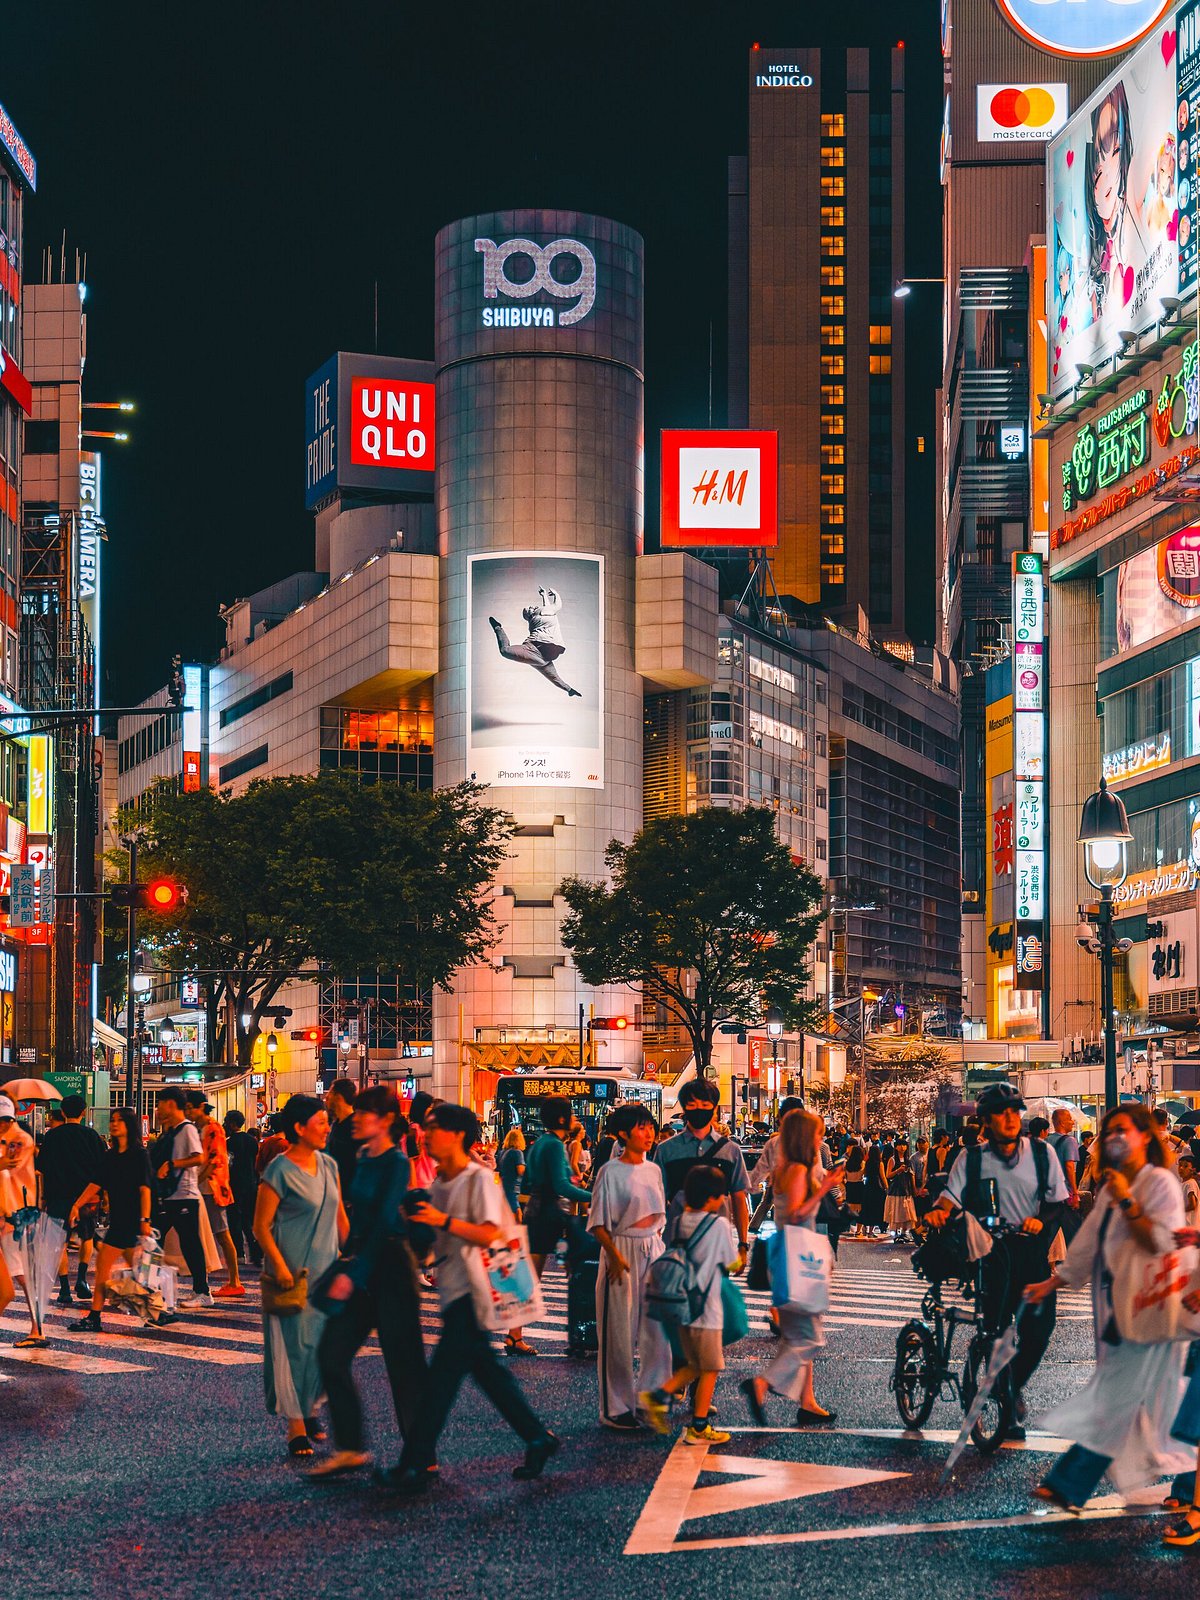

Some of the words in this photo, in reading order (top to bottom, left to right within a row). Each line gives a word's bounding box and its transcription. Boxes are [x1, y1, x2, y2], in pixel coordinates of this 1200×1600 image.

[756, 75, 813, 87] INDIGO
[768, 65, 800, 73] HOTEL
[993, 129, 1053, 139] mastercard
[474, 238, 596, 326] 109
[482, 307, 554, 327] SHIBUYA
[313, 379, 330, 434] THE
[361, 389, 420, 423] UNI
[307, 425, 335, 490] PRIME
[361, 424, 426, 460] QLO
[1006, 452, 1019, 460] 7F
[1098, 411, 1147, 489] 西村
[80, 462, 96, 499] BIC
[692, 469, 749, 506] H&M
[1062, 462, 1072, 512] 渋谷
[80, 504, 96, 597] CAMERA
[1020, 577, 1038, 628] 渋谷西村
[1022, 644, 1036, 655] 4F
[497, 770, 525, 779] iPhone
[525, 770, 535, 778] 14
[523, 759, 546, 767] ダンス!
[32, 768, 43, 799] レイク
[1019, 800, 1029, 835] パーラー
[1030, 795, 1039, 830] フルーツ
[21, 869, 32, 923] 渋谷駅前
[42, 872, 51, 922] スクランブル式
[1019, 870, 1029, 904] フルーツ
[1030, 865, 1039, 901] 渋谷西村
[1022, 935, 1043, 973] HUB
